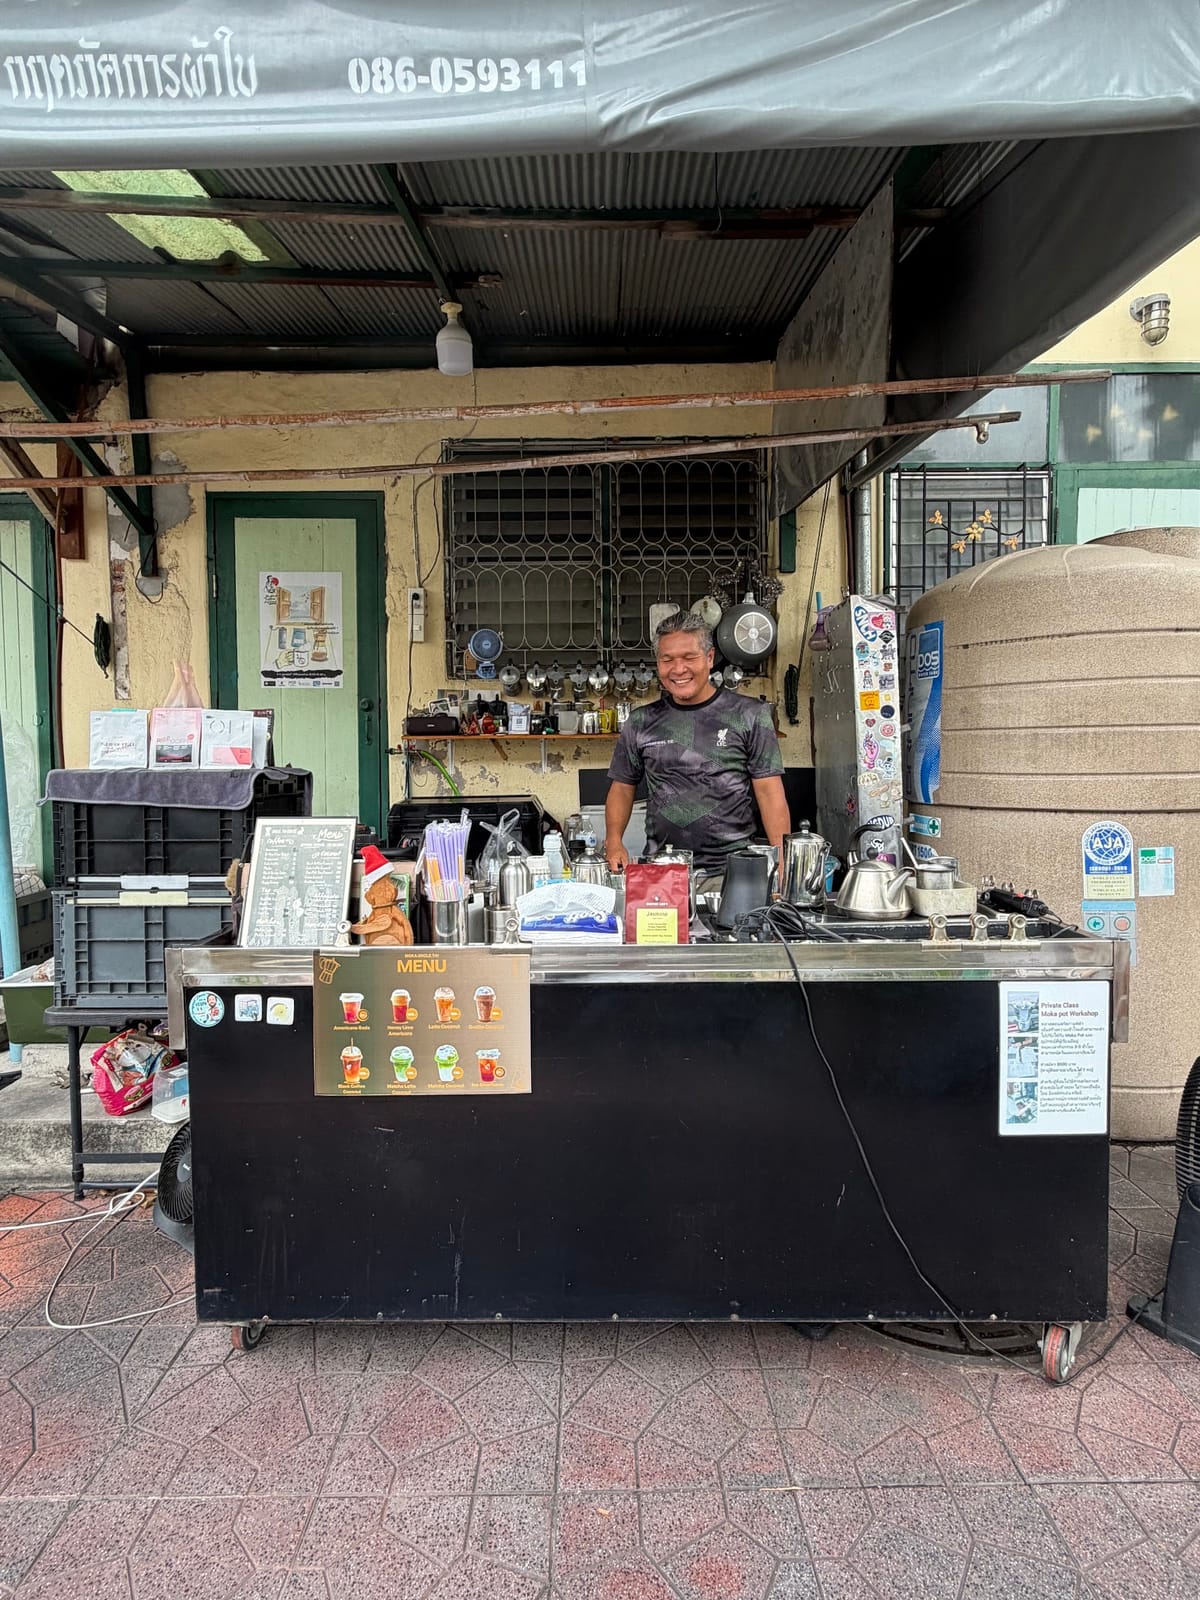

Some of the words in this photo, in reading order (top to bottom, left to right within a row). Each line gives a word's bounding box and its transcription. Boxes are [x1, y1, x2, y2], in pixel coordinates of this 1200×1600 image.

[347, 57, 589, 95] 086-0593111
[1092, 837, 1124, 849] AJA
[397, 959, 447, 973] MENU
[1058, 1010, 1069, 1018] pot
[1069, 1010, 1099, 1018] Workshop
